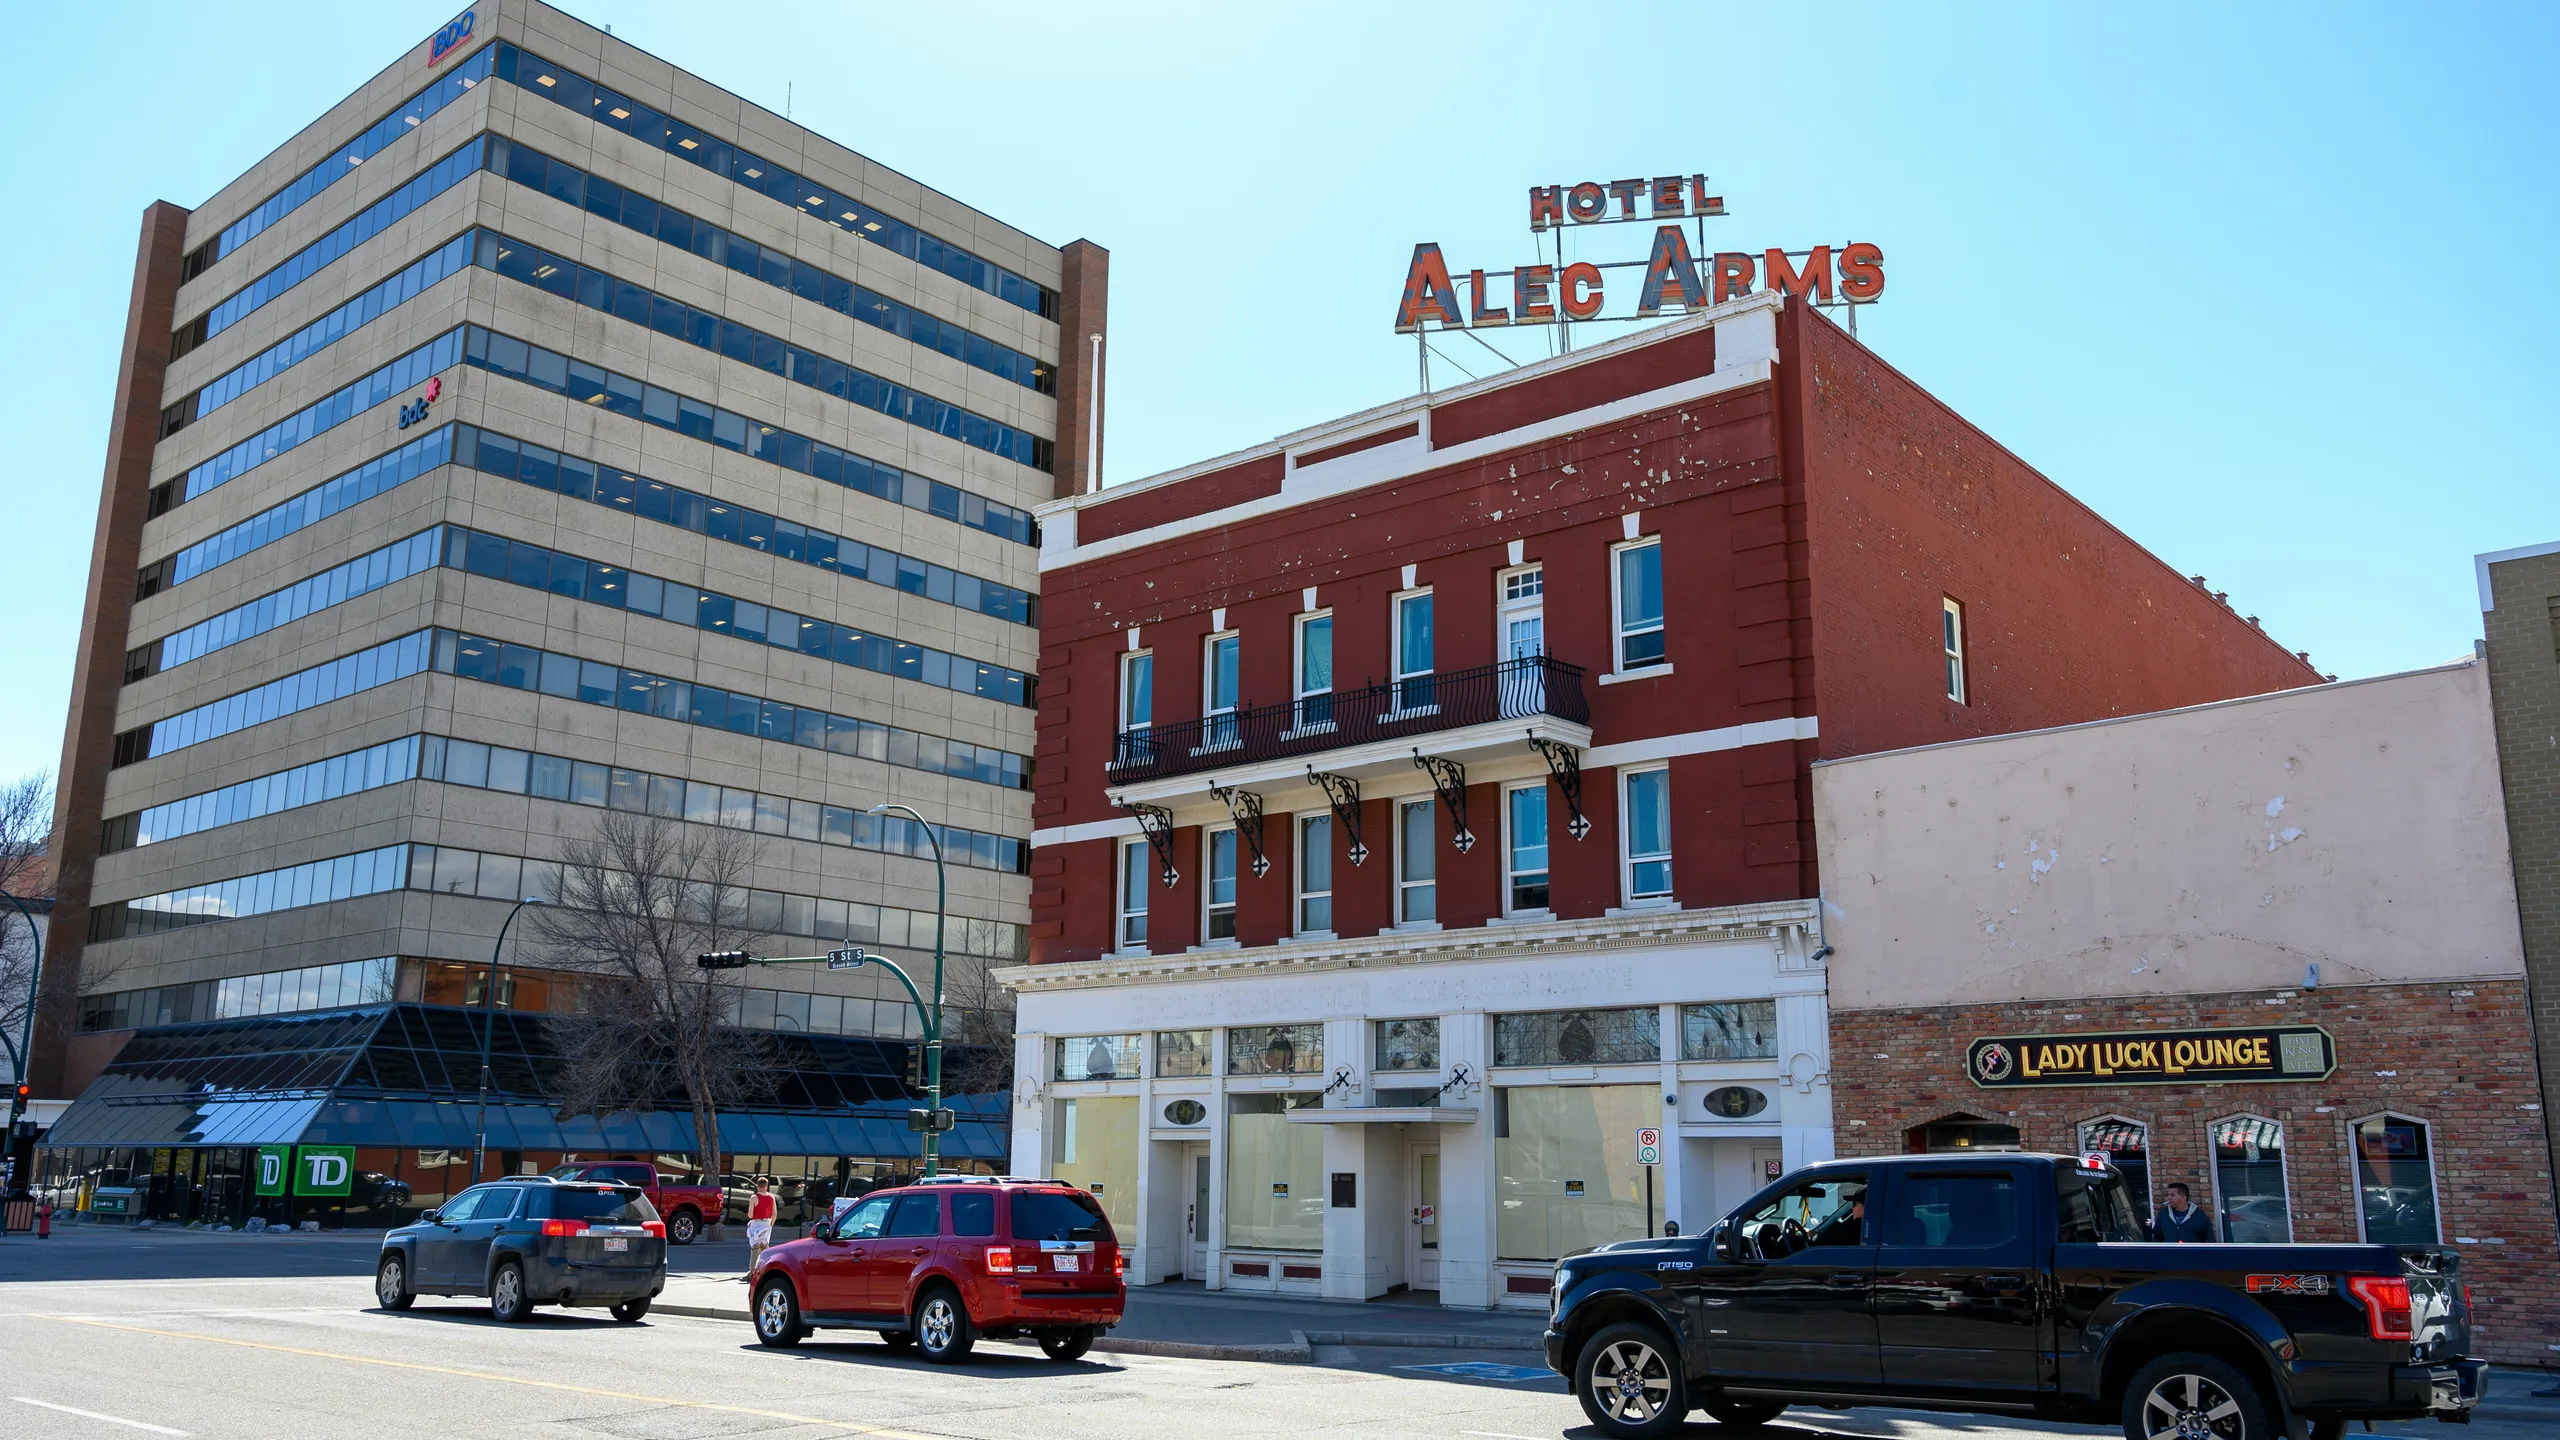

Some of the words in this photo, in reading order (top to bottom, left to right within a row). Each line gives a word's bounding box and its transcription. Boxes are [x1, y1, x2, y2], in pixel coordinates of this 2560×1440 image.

[433, 10, 475, 58] BDO
[1530, 174, 1724, 232] HOTEL
[1394, 241, 1605, 334] ALEC
[1636, 224, 1886, 317] ARMS
[399, 397, 430, 430] bdc
[829, 952, 835, 962] 5
[840, 951, 851, 961] St
[856, 949, 862, 959] S
[2020, 1044, 2088, 1077] LADY
[2092, 1040, 2160, 1076] LUCK
[2162, 1037, 2271, 1074] LOUNGE
[261, 1154, 282, 1186] TD
[304, 1154, 348, 1186] TD
[2245, 1273, 2330, 1293] FX4
